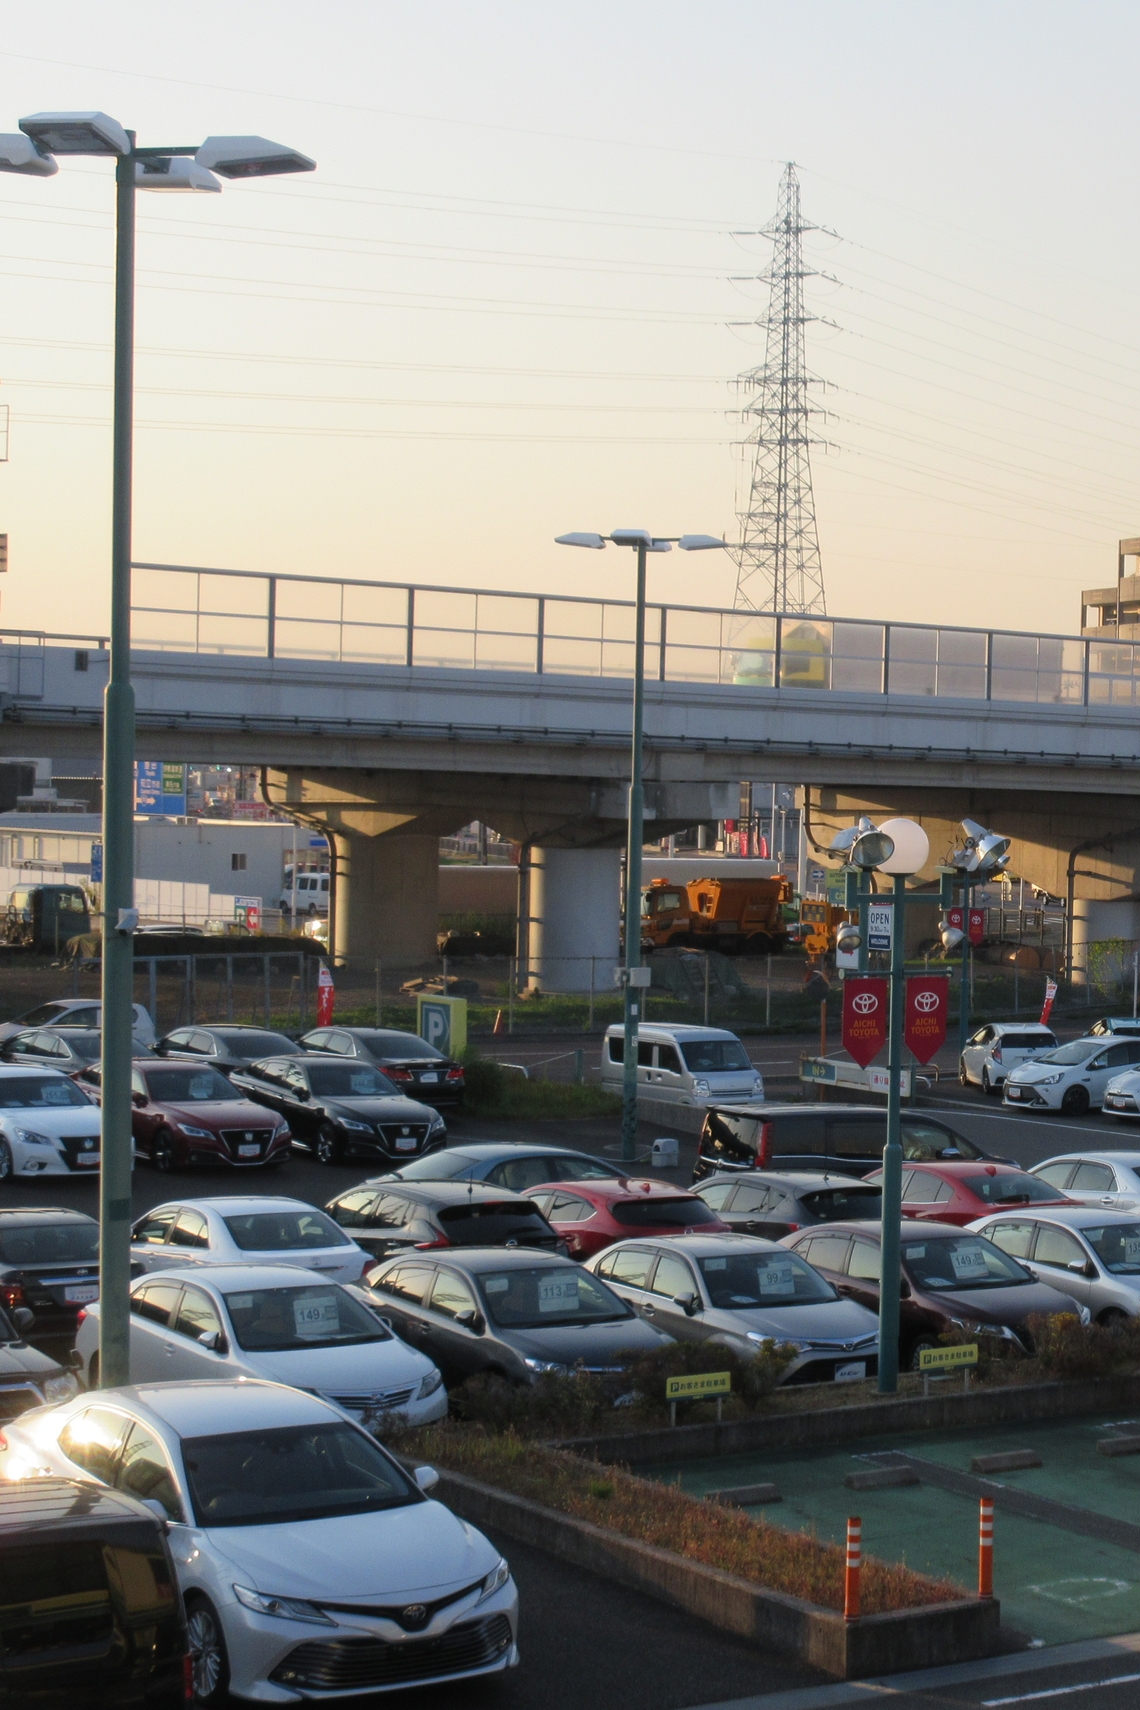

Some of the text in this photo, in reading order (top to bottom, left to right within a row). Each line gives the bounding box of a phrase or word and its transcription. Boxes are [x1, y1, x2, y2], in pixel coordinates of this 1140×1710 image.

[870, 913, 889, 924] OPEN
[428, 1012, 444, 1046] P
[853, 1020, 876, 1028] AICHI
[849, 1028, 879, 1037] TOYOTA
[911, 1026, 939, 1034] TOYOTA
[767, 1273, 778, 1283] 99
[544, 1286, 561, 1297] 113
[932, 1350, 974, 1362] お客さま駐車場
[681, 1379, 726, 1390] お客さま駐車場
